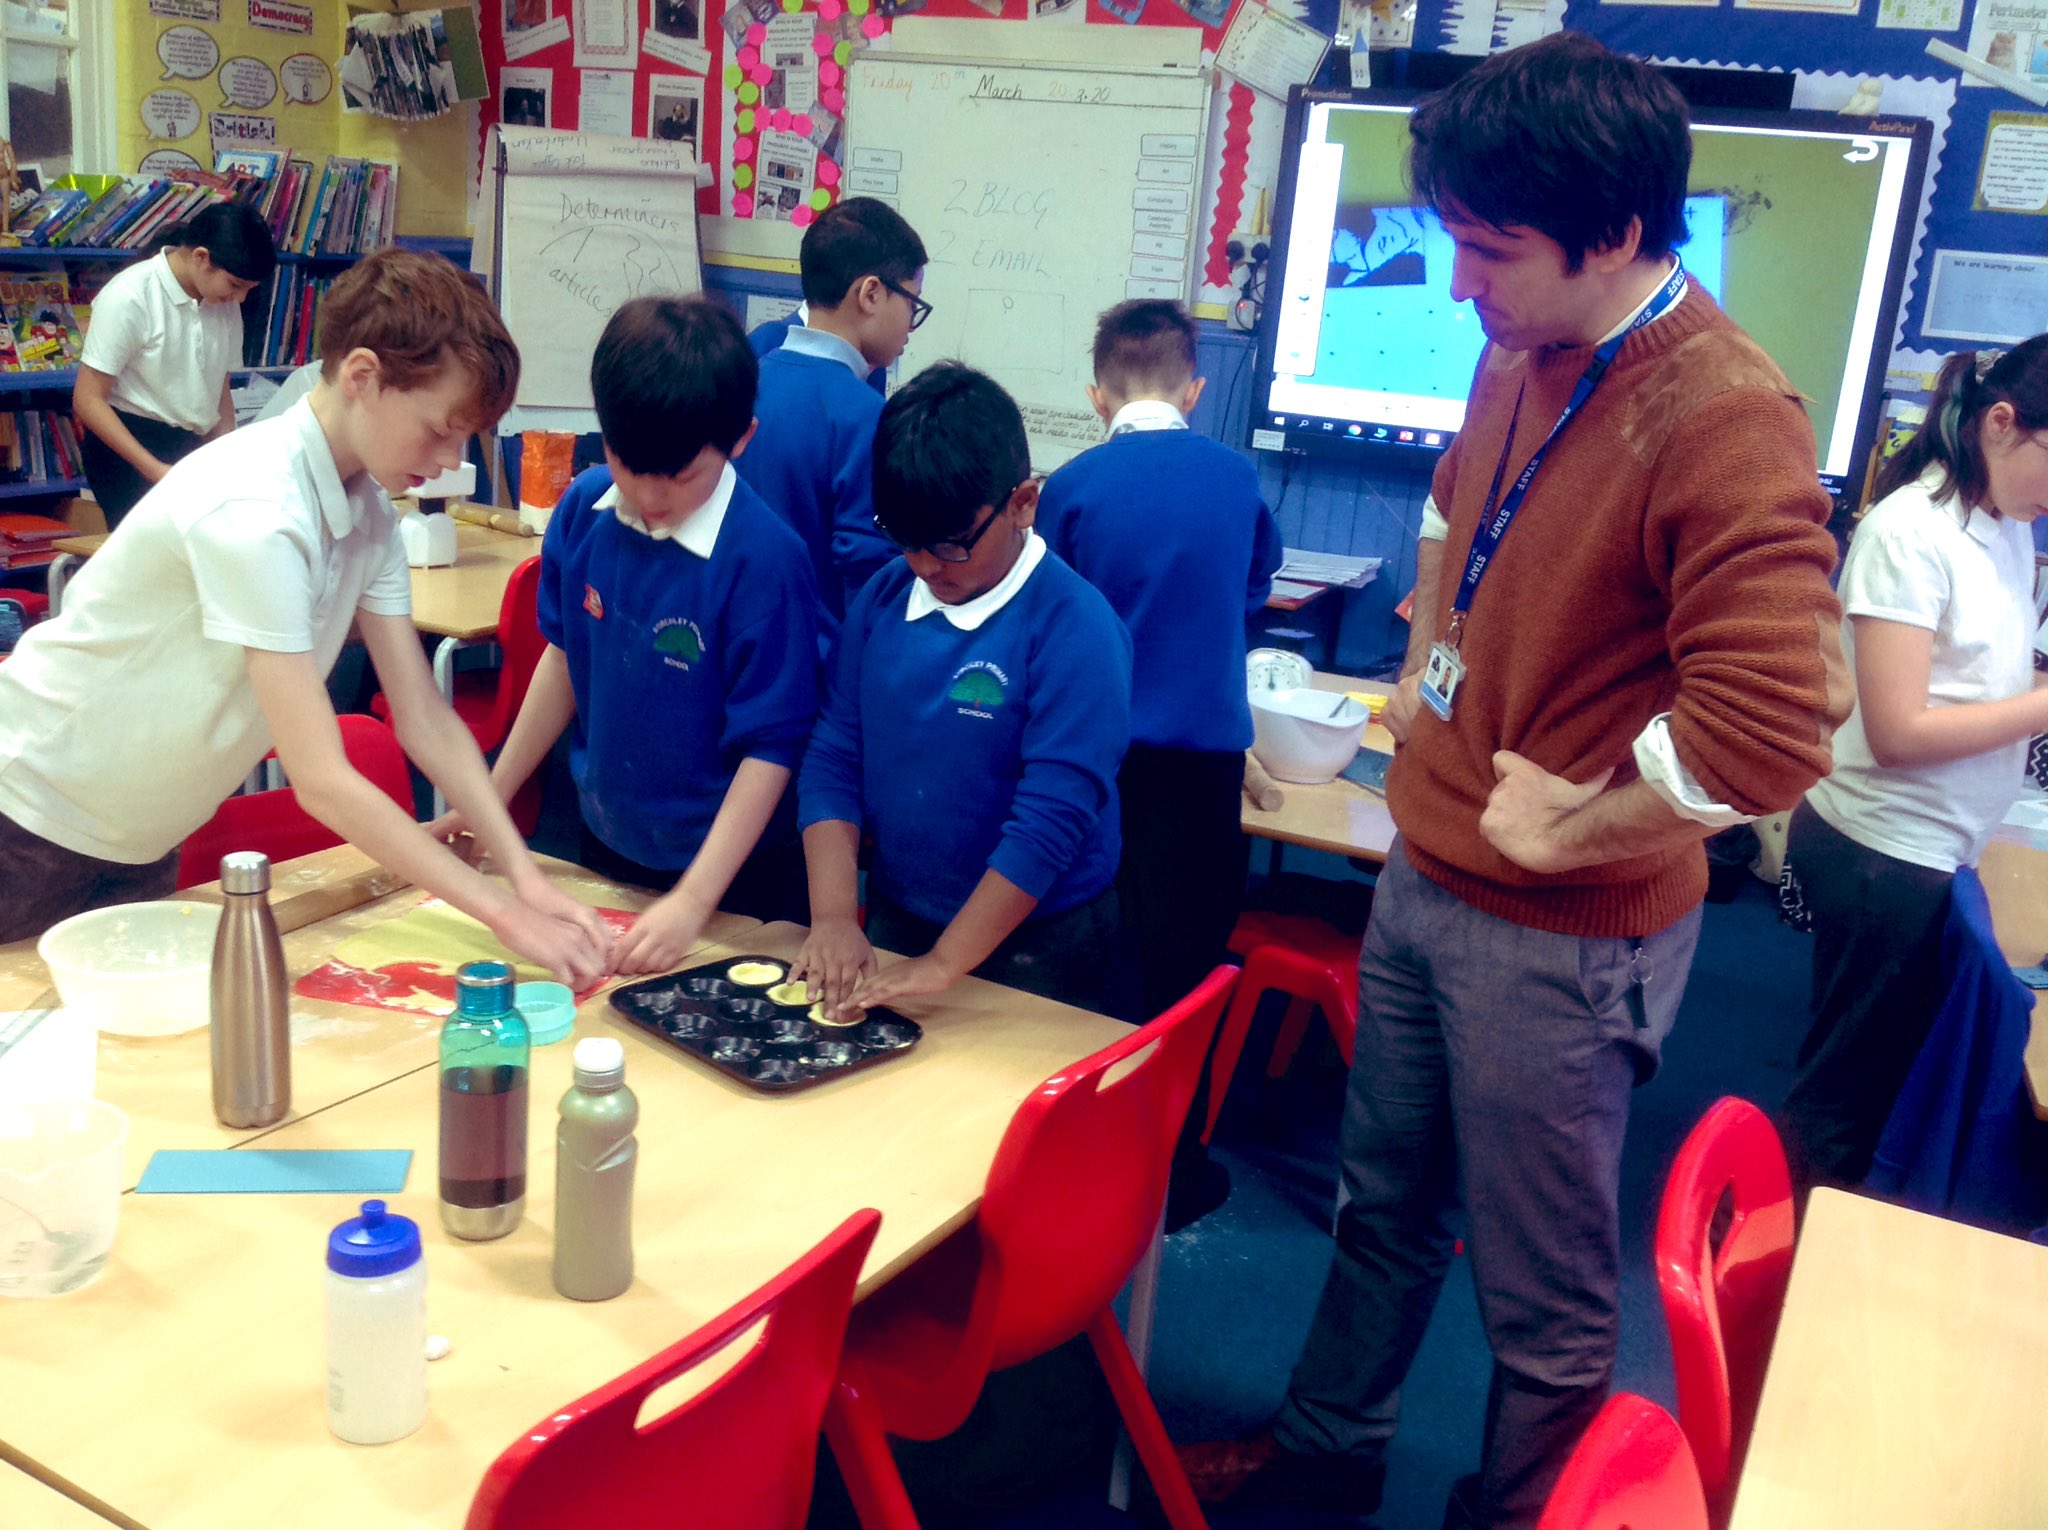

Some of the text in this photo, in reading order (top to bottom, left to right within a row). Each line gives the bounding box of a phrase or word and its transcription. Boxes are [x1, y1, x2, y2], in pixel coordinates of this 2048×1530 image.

[252, 1, 312, 31] Democracy
[861, 68, 914, 104] Friday
[974, 73, 1024, 100] March
[560, 192, 681, 233] Determiners
[943, 179, 1057, 230] 2 BLOG
[931, 229, 1052, 279] 2 EMAIL
[1953, 259, 1966, 267] We
[1983, 262, 2012, 273] learning
[1667, 268, 1686, 298] STAFF
[1516, 459, 1539, 491] STAFF
[1489, 508, 1511, 540] STAFF
[1467, 554, 1487, 584] STAFF
[663, 656, 690, 672] SCHOOL
[957, 707, 995, 720] SCHOOL
